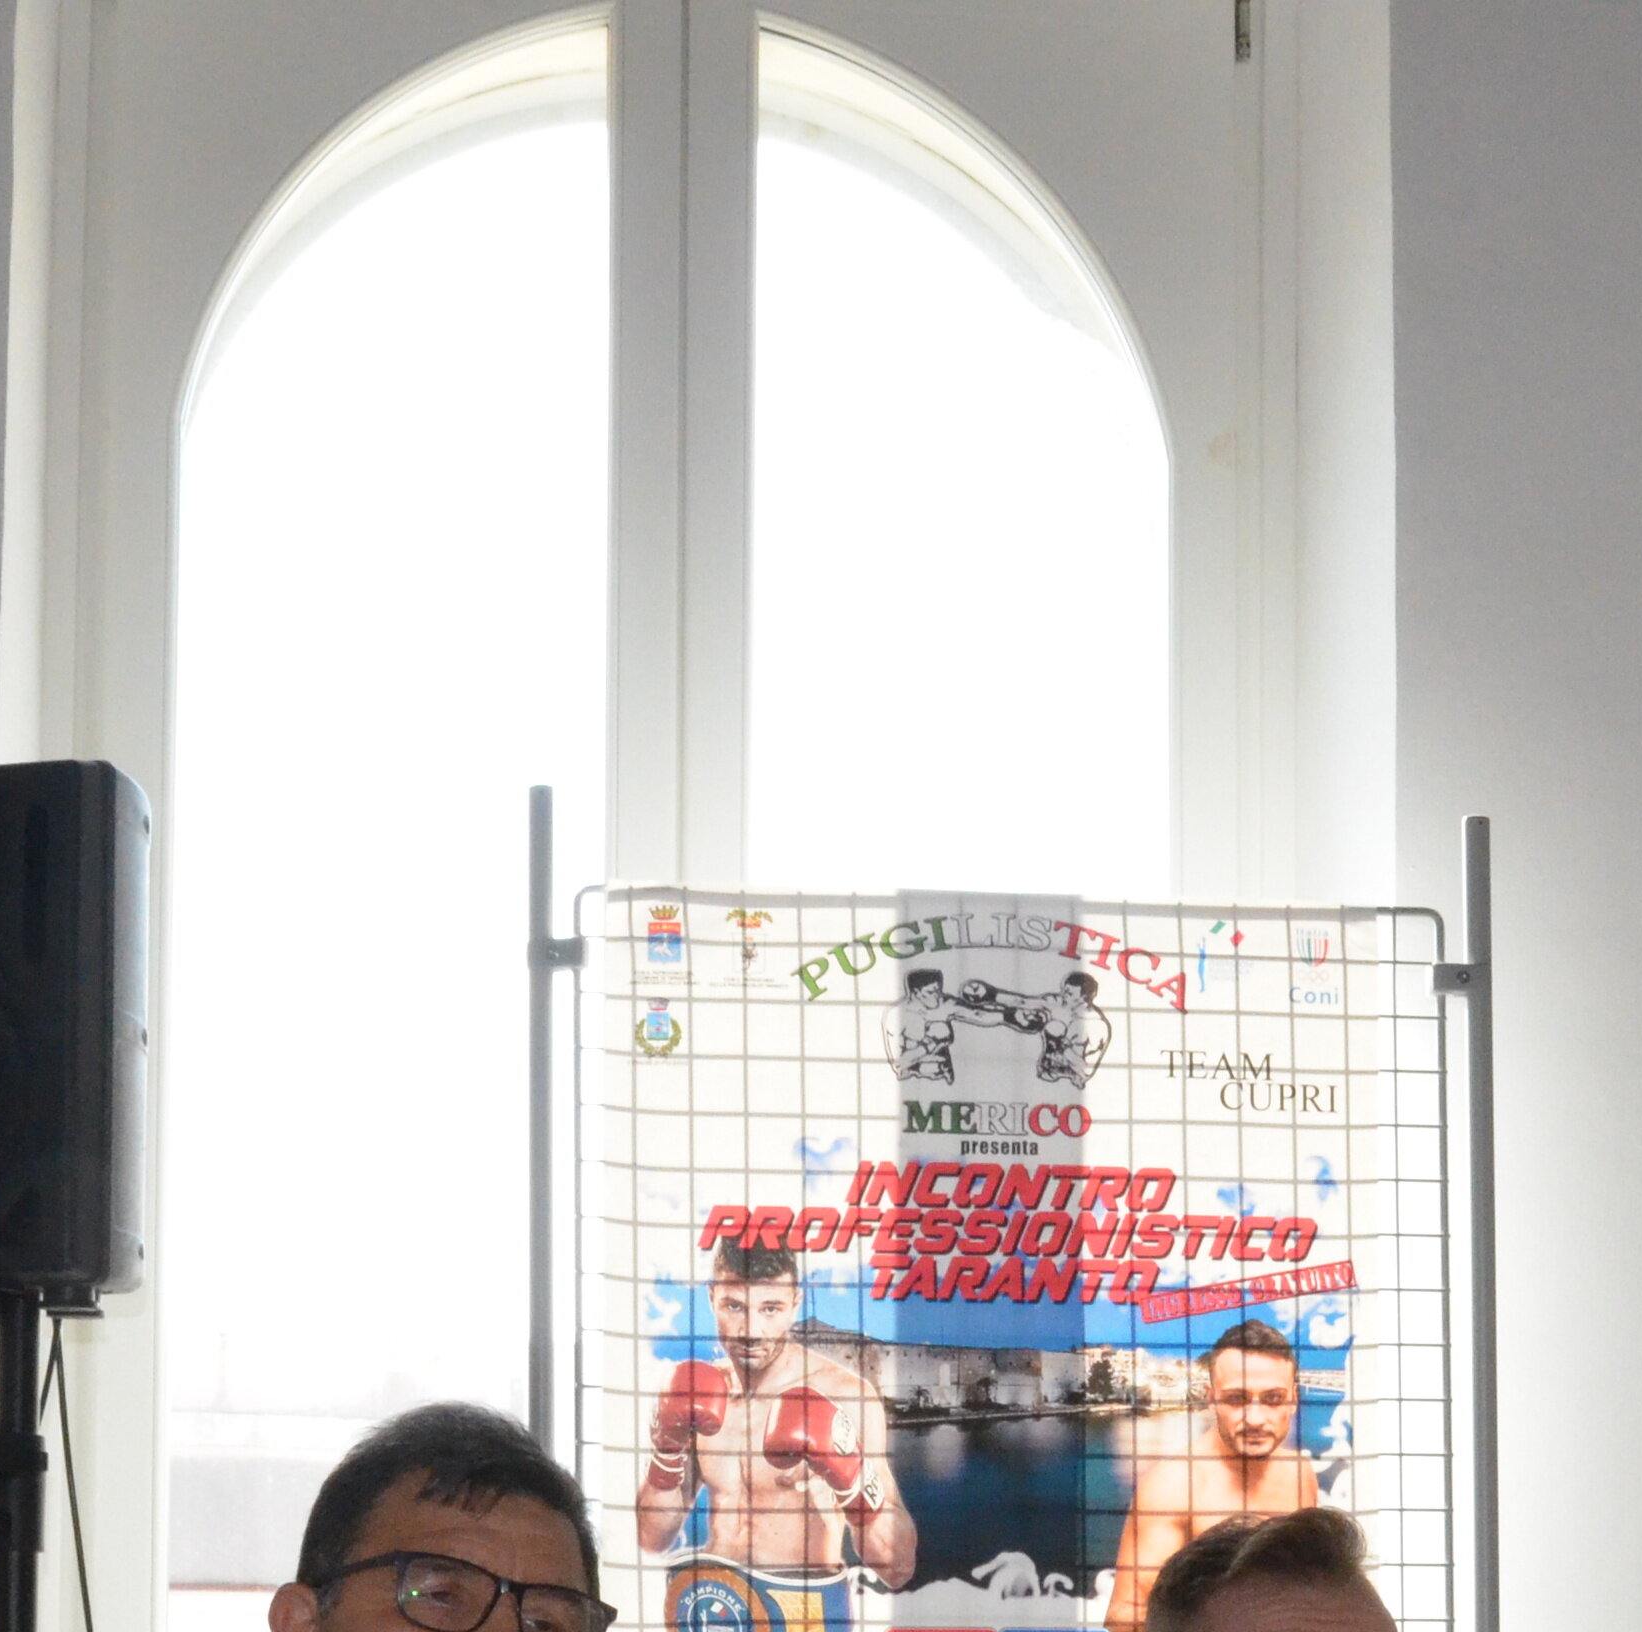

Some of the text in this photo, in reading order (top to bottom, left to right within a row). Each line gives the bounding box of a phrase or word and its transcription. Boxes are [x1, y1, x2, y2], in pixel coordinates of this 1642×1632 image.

[790, 912, 1188, 1014] PUGILISTICA
[1289, 986, 1339, 1005] Coni
[1160, 1049, 1273, 1081] TEAM
[1220, 1081, 1339, 1113] CUPRI
[902, 1100, 1092, 1137] MERICO
[961, 1139, 1039, 1156] presenta
[845, 1160, 1177, 1212] INCONTRO
[697, 1205, 1318, 1261] PROFESSIONISTICO
[869, 1256, 1159, 1305] TARANTO
[1250, 1262, 1353, 1299] GRATUITO
